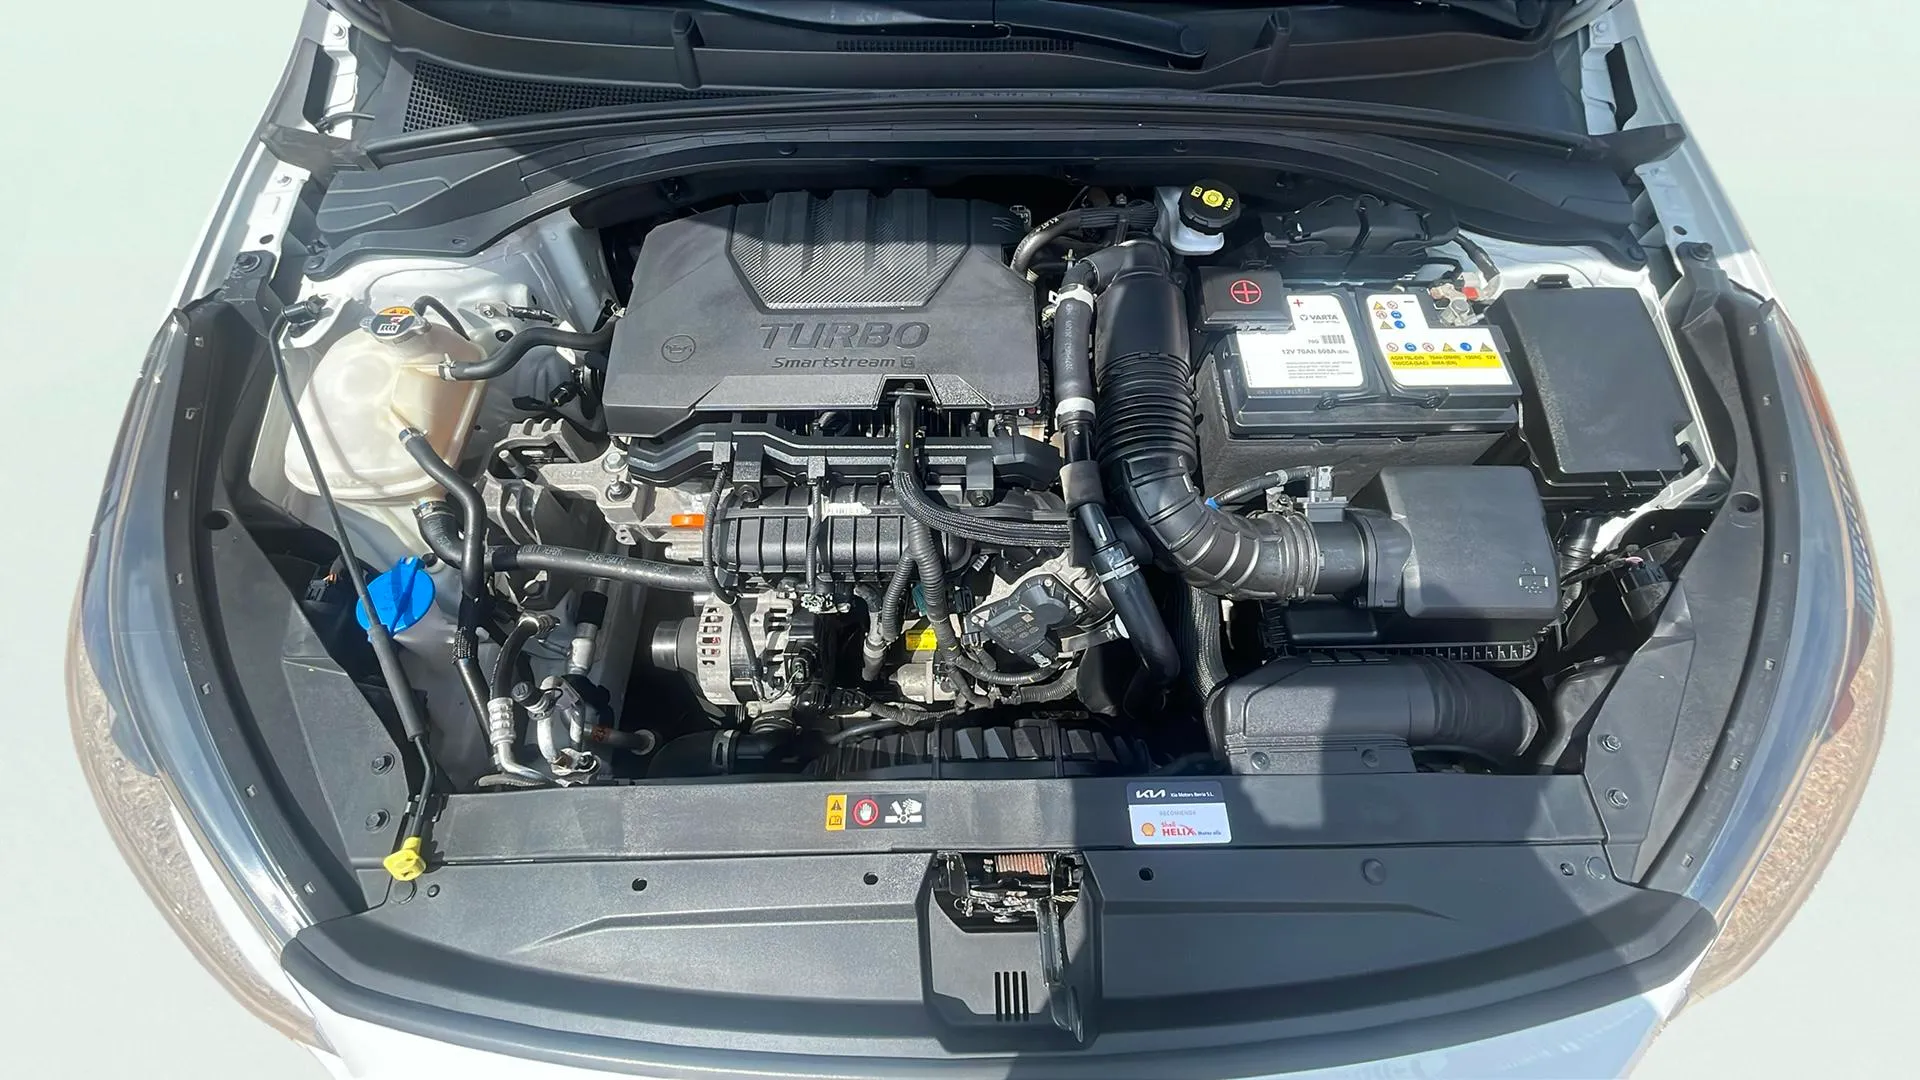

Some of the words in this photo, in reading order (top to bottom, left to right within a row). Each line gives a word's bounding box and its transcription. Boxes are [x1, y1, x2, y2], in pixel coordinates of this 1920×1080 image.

[759, 321, 931, 350] TURBO
[771, 357, 896, 369] Smartstream
[1135, 789, 1166, 798] KIA
[1162, 827, 1196, 836] HELIX
